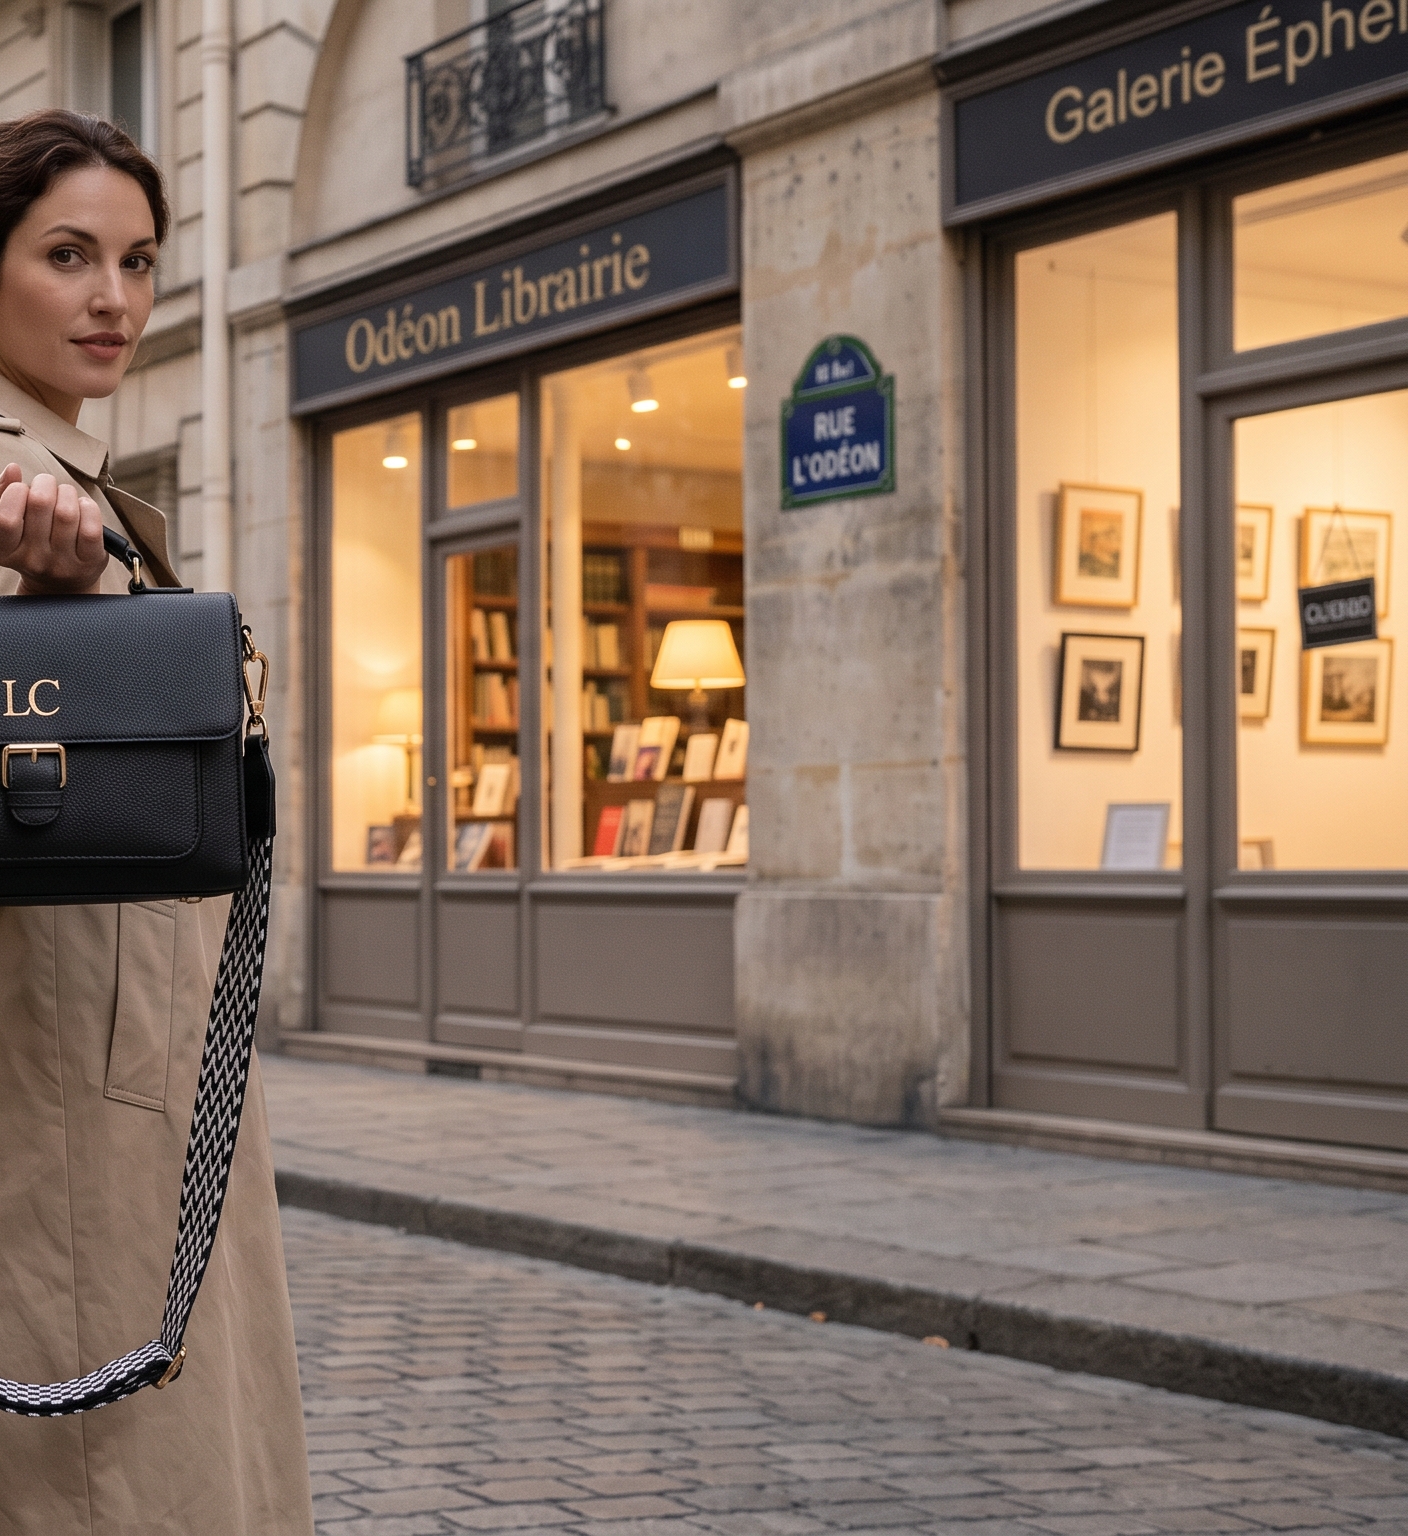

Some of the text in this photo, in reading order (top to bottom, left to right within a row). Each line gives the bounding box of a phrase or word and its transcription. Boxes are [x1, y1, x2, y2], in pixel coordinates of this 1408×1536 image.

[1045, 0, 1408, 145] Galerie Éphe
[345, 232, 650, 374] Odéon Librairie
[814, 406, 856, 442] RUE
[793, 439, 880, 486] L'ODÉON
[1, 679, 60, 716] LC
